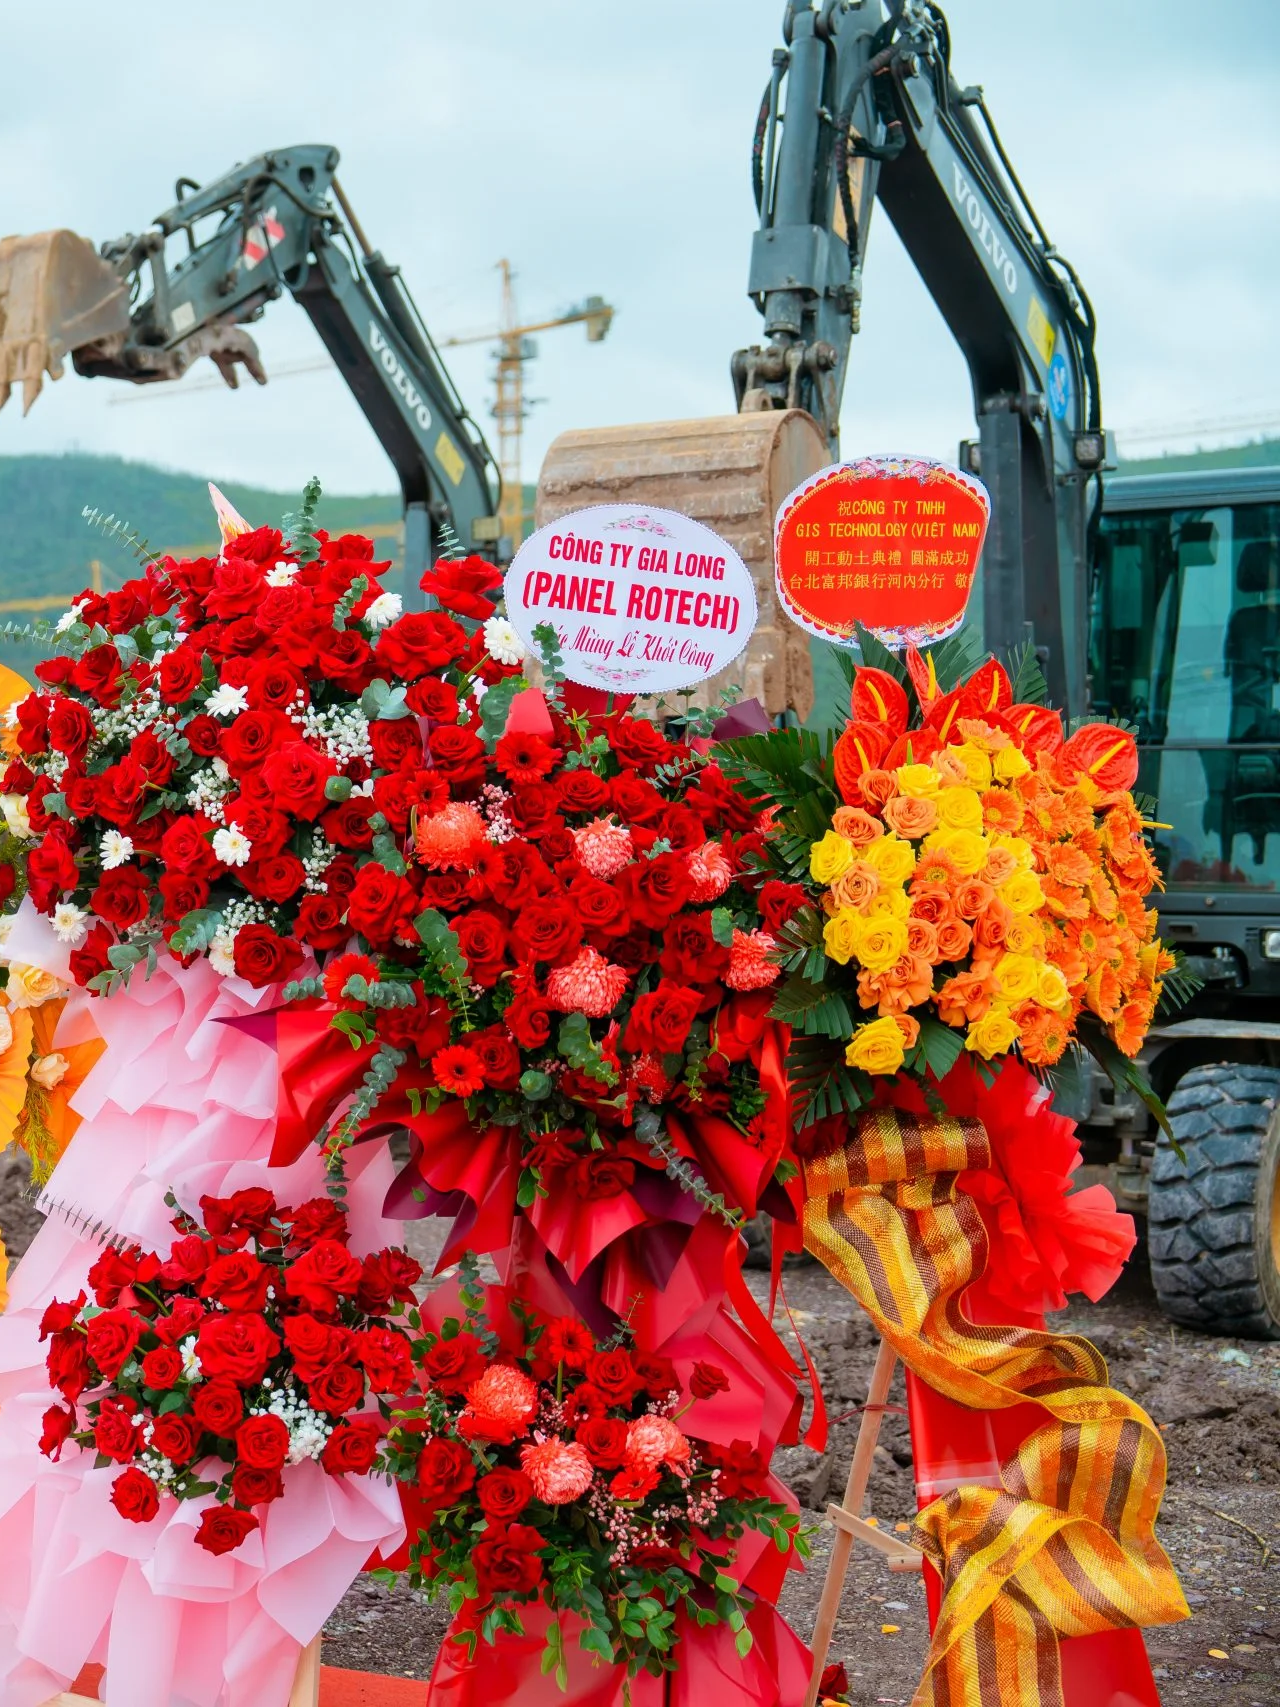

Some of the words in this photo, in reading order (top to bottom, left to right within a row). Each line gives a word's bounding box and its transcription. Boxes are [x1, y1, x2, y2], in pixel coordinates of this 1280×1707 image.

[952, 161, 1018, 294] VOLVO
[369, 320, 432, 430] VOLVO
[796, 523, 820, 537] GIS
[953, 523, 981, 538] NAM)
[893, 501, 908, 515] TY
[916, 501, 945, 515] TNHH
[548, 532, 604, 565] CÔNG
[610, 543, 634, 568] TY
[638, 547, 668, 573] GIA
[673, 551, 726, 580] LONG
[805, 549, 902, 566] 開工動土典禮
[911, 549, 969, 566] 圓滿成功
[522, 570, 617, 616] (PANEL
[626, 583, 740, 635] ROTECH)
[569, 625, 615, 661] Mừng
[616, 630, 640, 658] Lễ
[679, 638, 715, 674] Công
